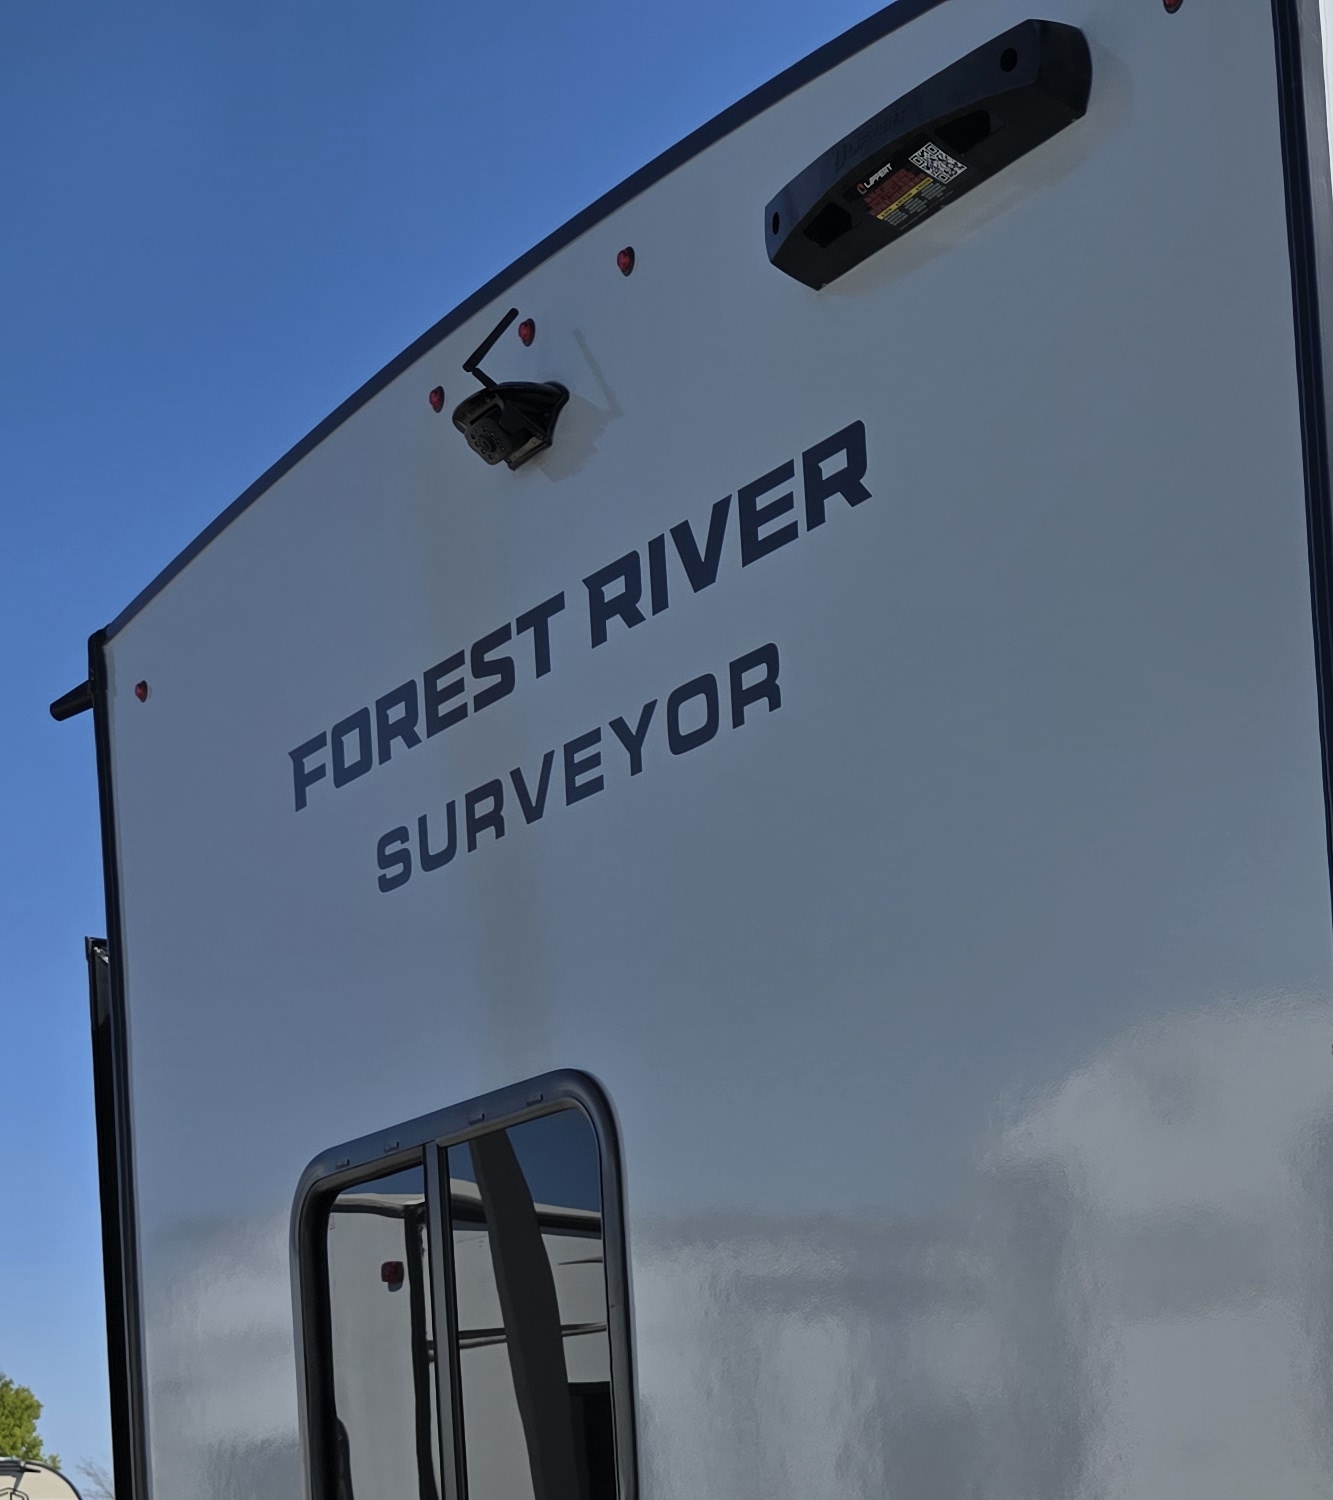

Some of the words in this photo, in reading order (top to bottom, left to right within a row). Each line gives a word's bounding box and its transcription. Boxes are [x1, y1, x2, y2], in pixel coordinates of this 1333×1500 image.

[288, 590, 565, 813] FOREST
[582, 419, 873, 649] RIVER
[377, 642, 782, 893] SURVEYOR
